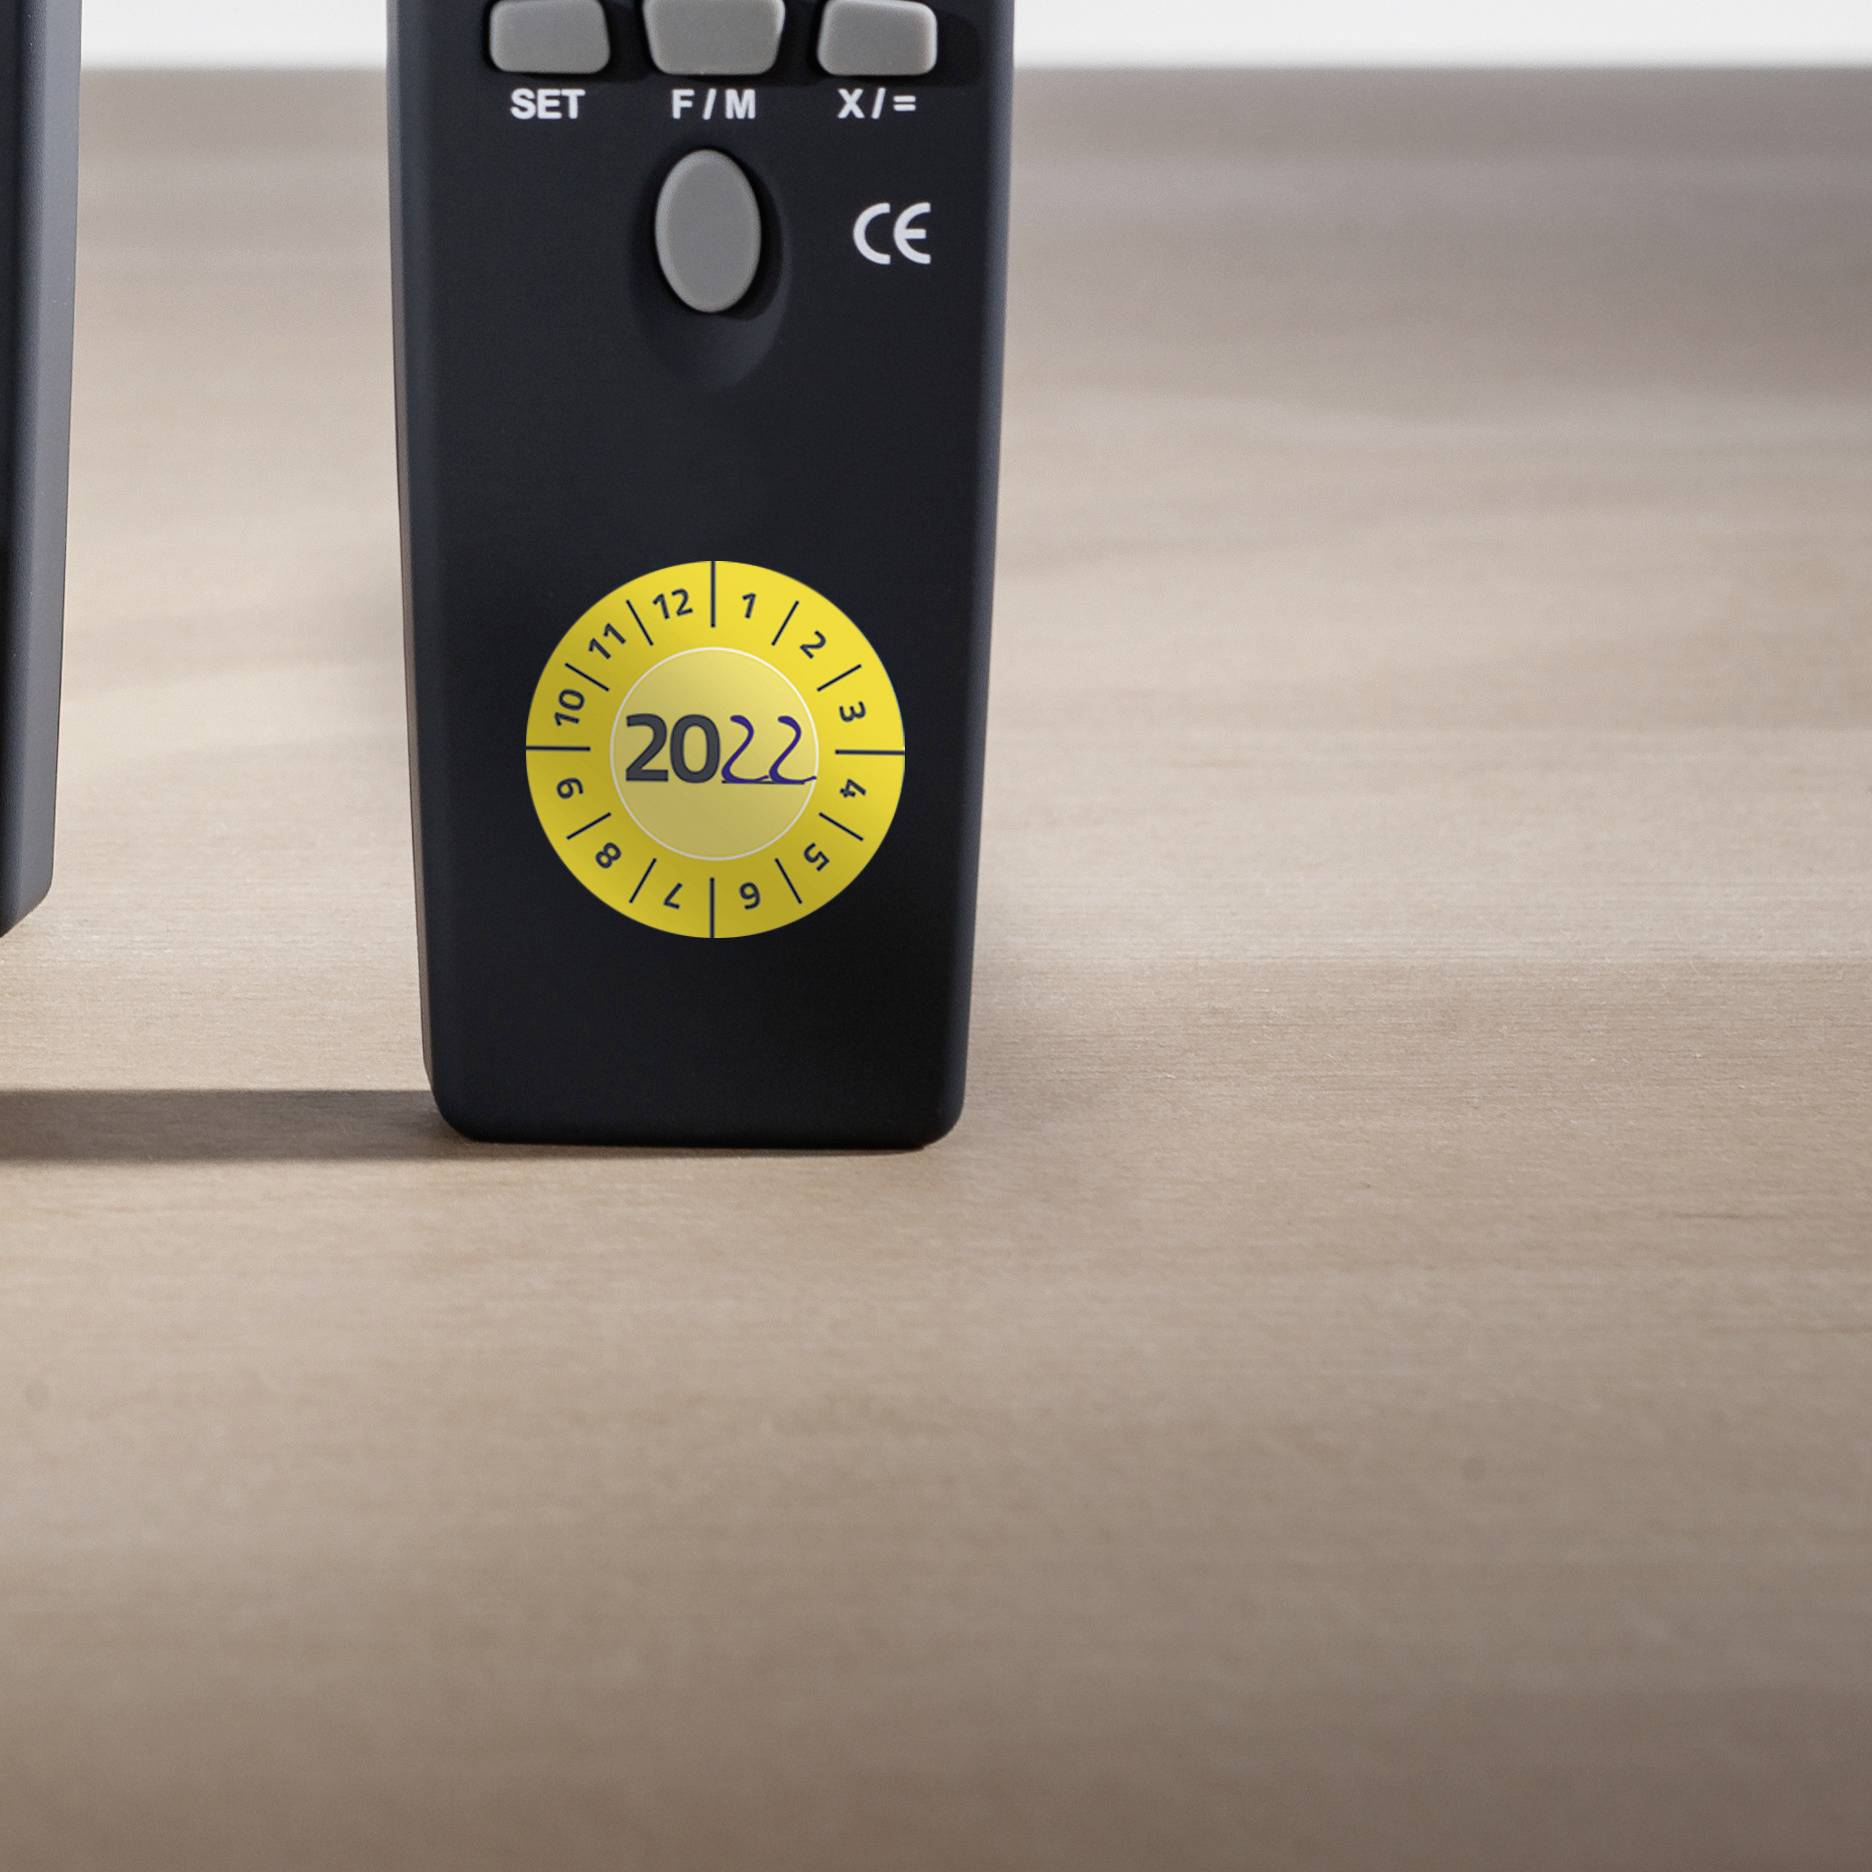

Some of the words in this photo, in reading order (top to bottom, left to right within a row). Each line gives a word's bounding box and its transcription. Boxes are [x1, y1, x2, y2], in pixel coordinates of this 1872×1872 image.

[509, 87, 586, 121] SET
[652, 589, 693, 620] 12
[742, 593, 756, 619] 1
[588, 623, 626, 660] 11
[800, 630, 826, 659] 2
[554, 689, 585, 727] 10
[839, 701, 866, 722] 3
[625, 713, 817, 785] 2022
[556, 777, 584, 799] 9
[839, 779, 866, 798] 4
[595, 842, 622, 869] 8
[803, 842, 830, 872] 5
[663, 882, 683, 910] 7
[739, 882, 761, 910] 6
